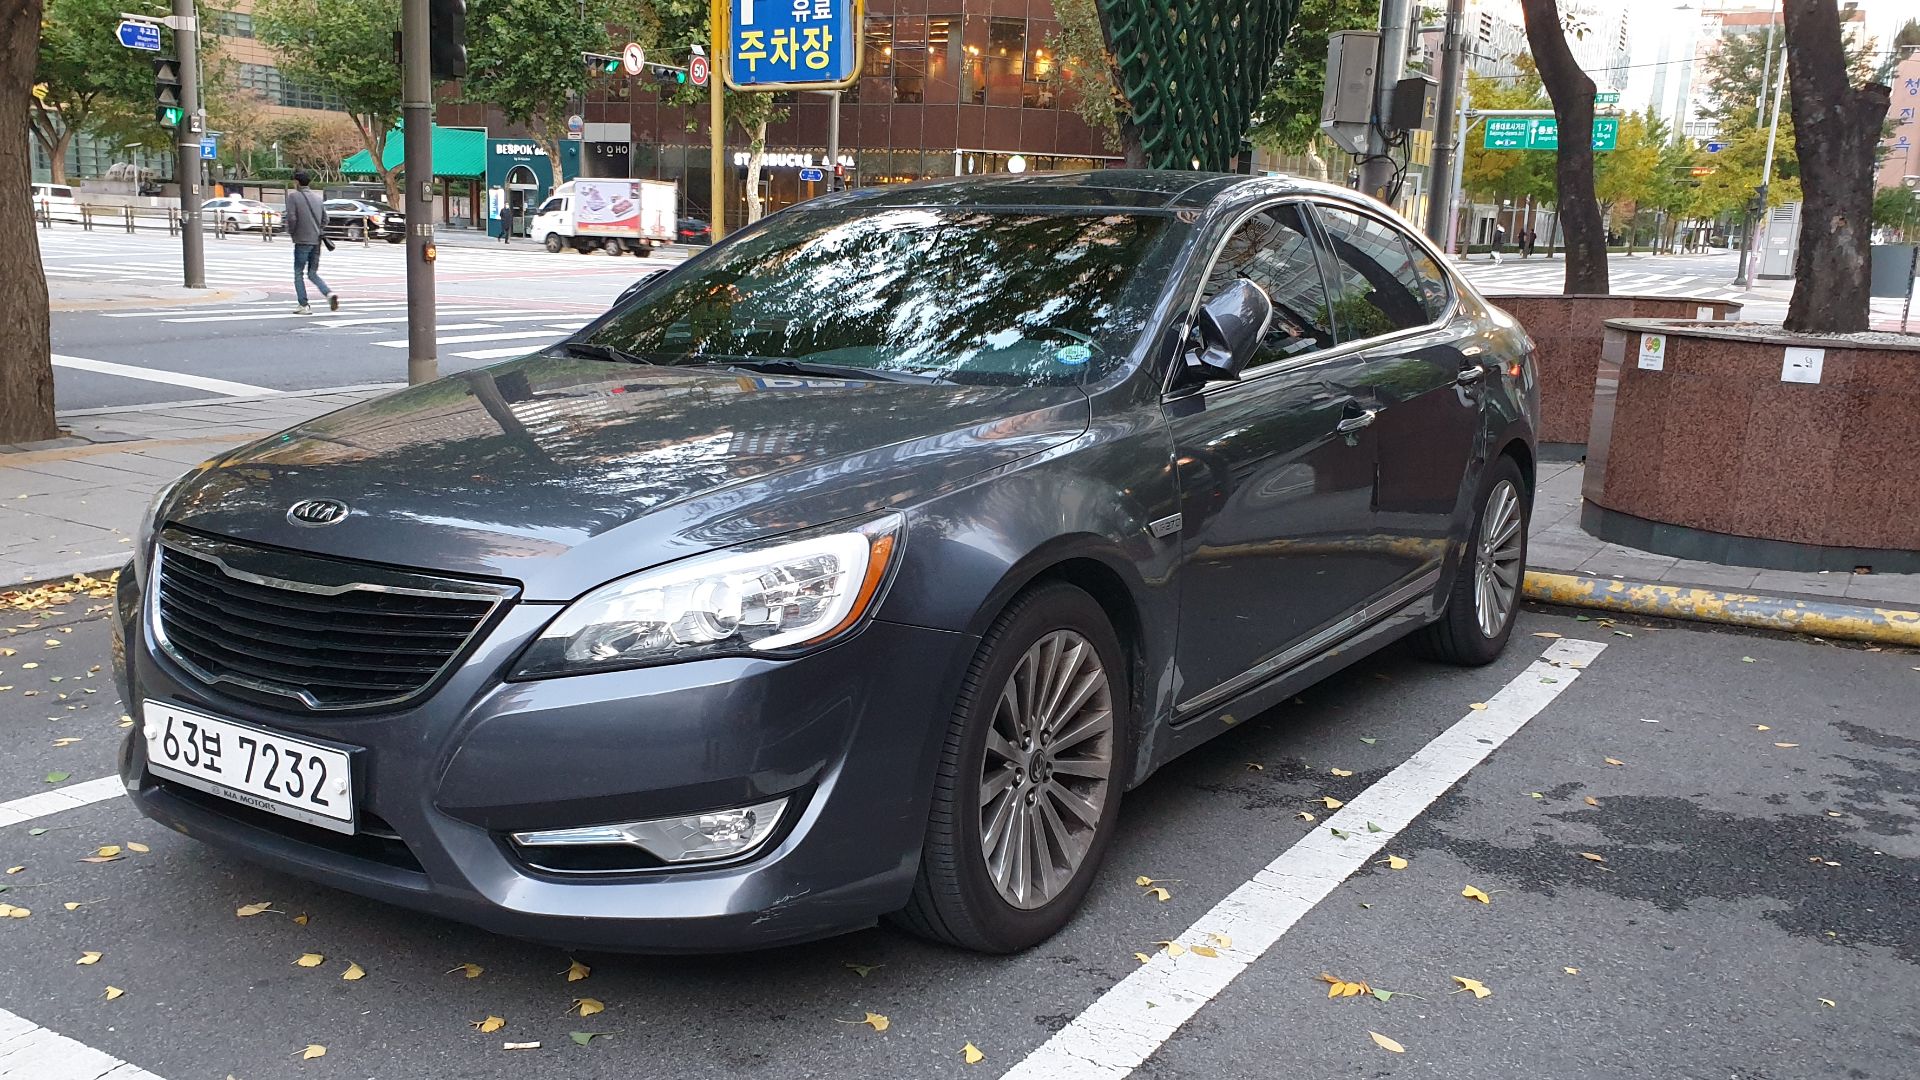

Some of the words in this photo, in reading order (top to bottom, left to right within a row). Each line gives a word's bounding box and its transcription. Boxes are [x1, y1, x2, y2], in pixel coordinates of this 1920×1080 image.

[791, 0, 833, 23] 유료
[738, 25, 833, 72] 주차장
[694, 64, 704, 78] 50
[204, 146, 211, 155] P
[733, 152, 813, 168] STRBUCKS
[296, 502, 338, 521] KIA
[163, 716, 222, 774] 63보
[238, 735, 329, 807] 7232
[223, 789, 238, 800] KIA
[239, 795, 276, 812] MOTORS
